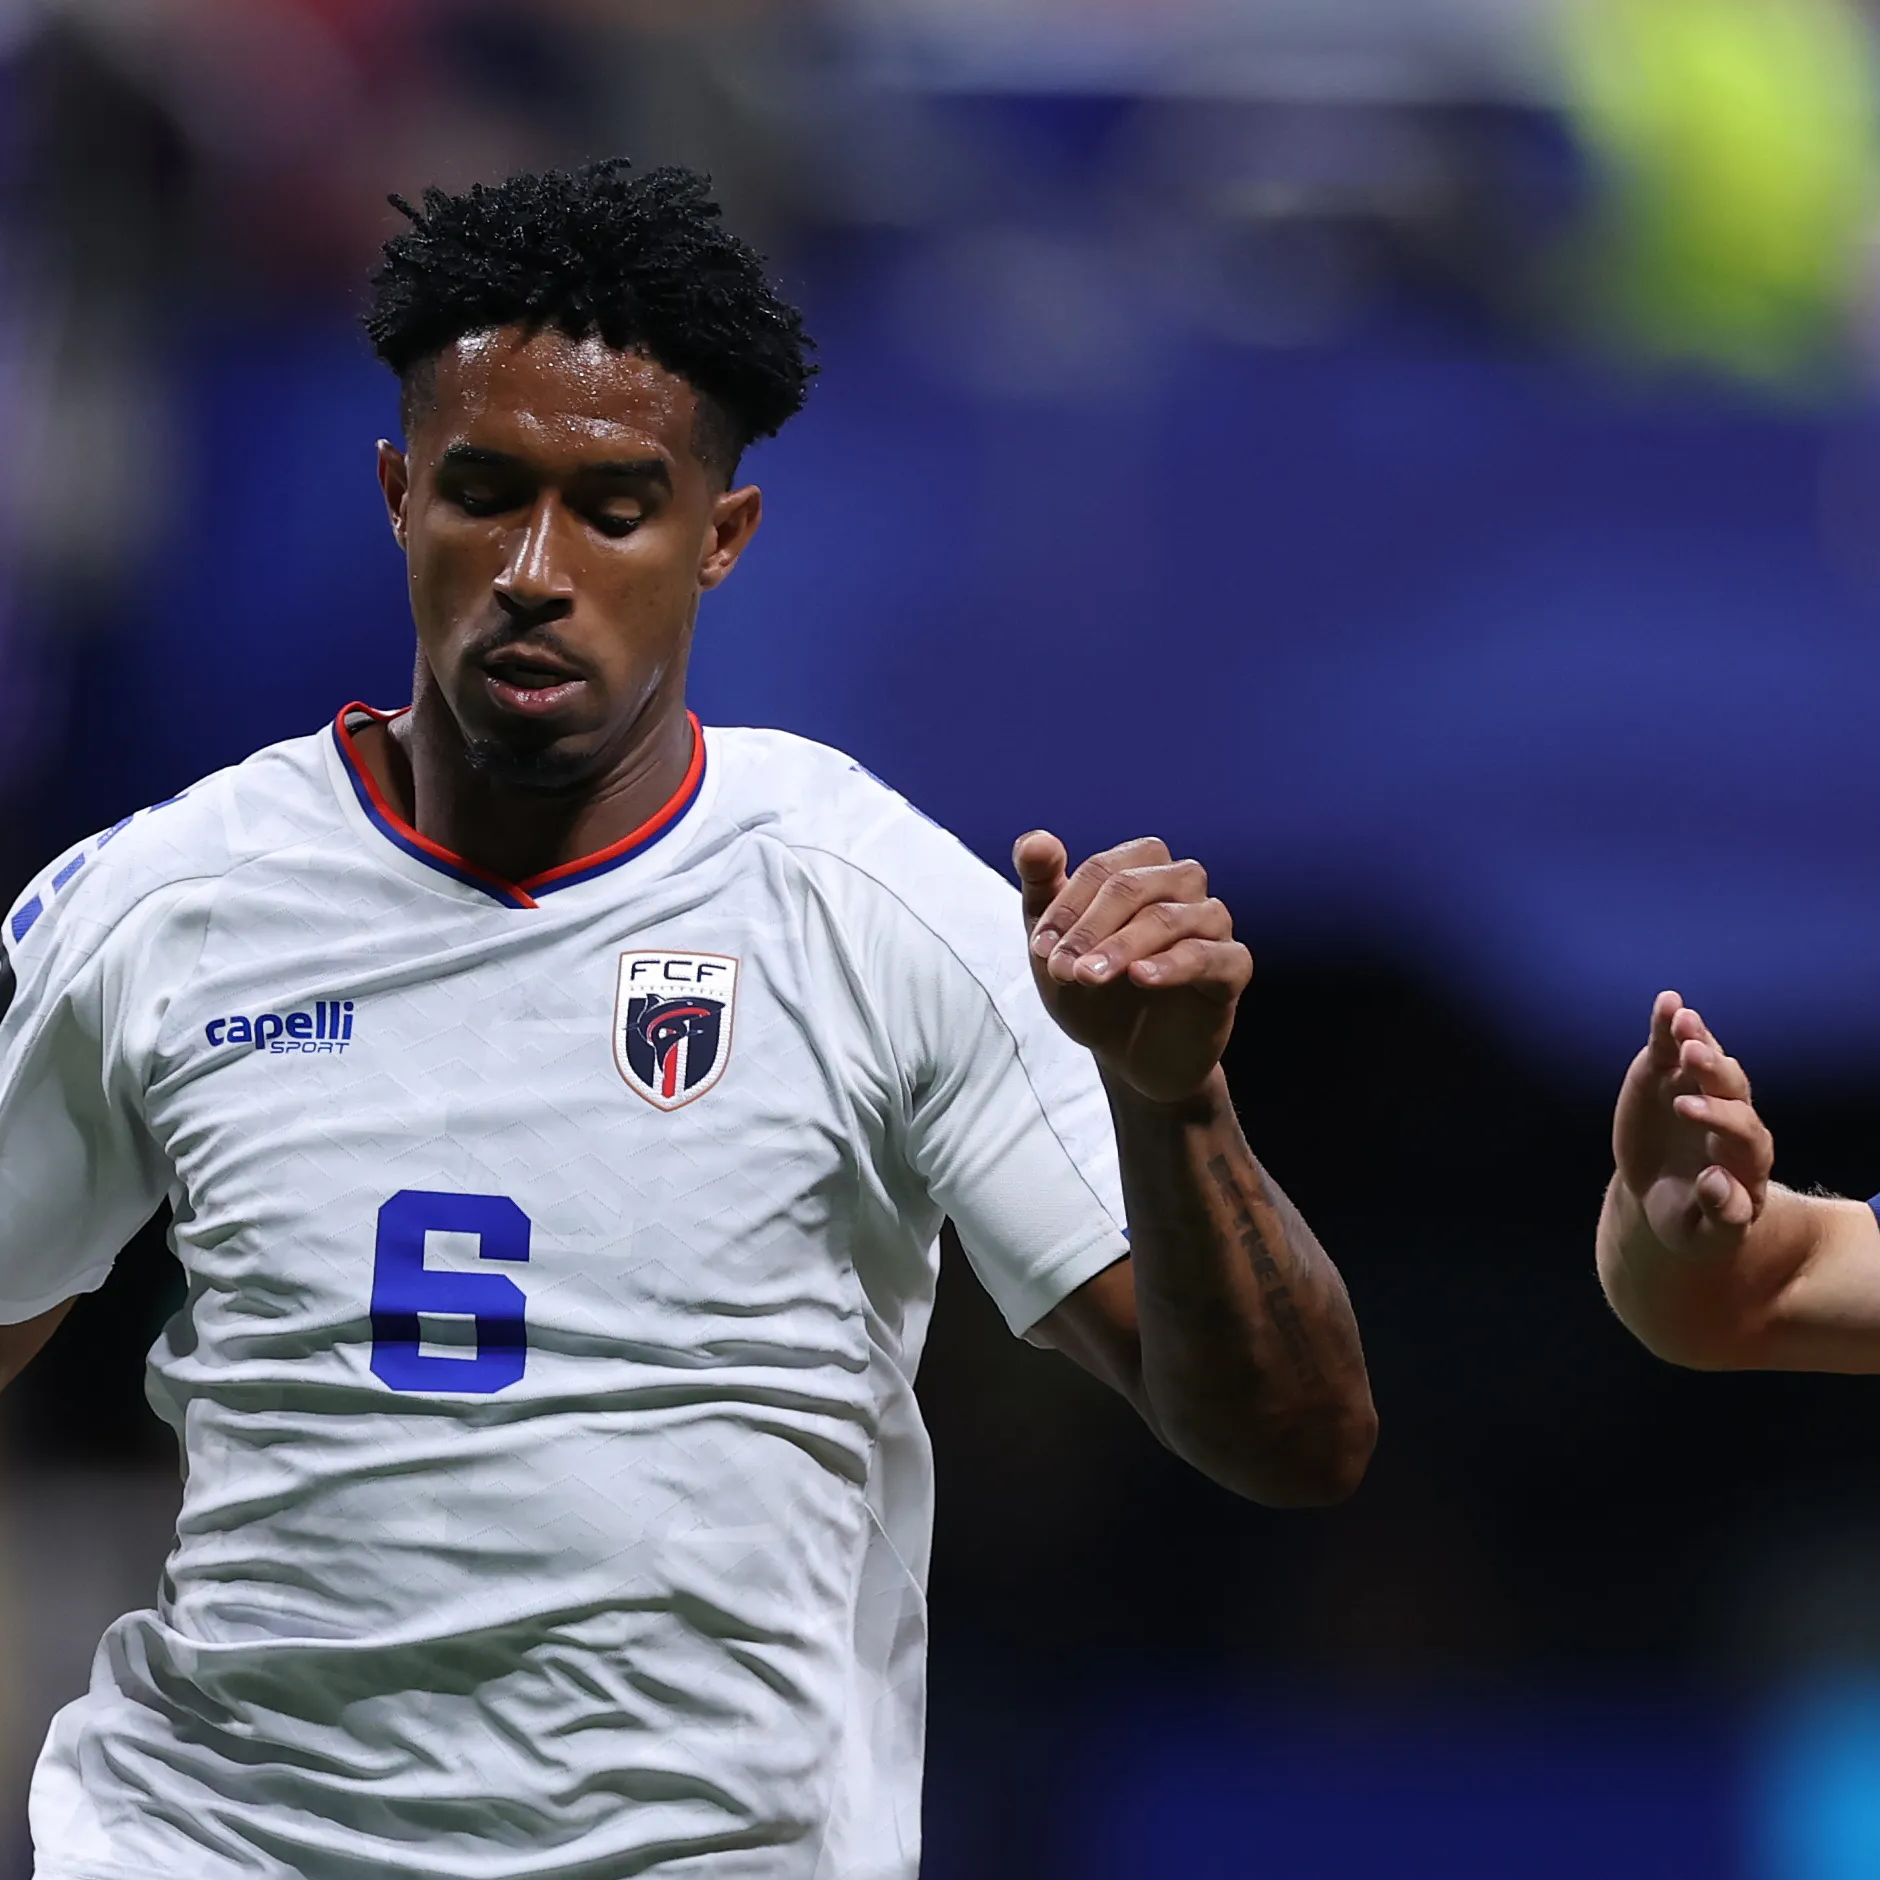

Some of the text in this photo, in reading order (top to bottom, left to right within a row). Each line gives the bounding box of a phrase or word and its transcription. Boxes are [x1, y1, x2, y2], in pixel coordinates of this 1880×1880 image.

[630, 959, 727, 983] FCF
[205, 1001, 354, 1050] capelli
[270, 1041, 350, 1054] SPORT
[369, 1189, 531, 1394] 6
